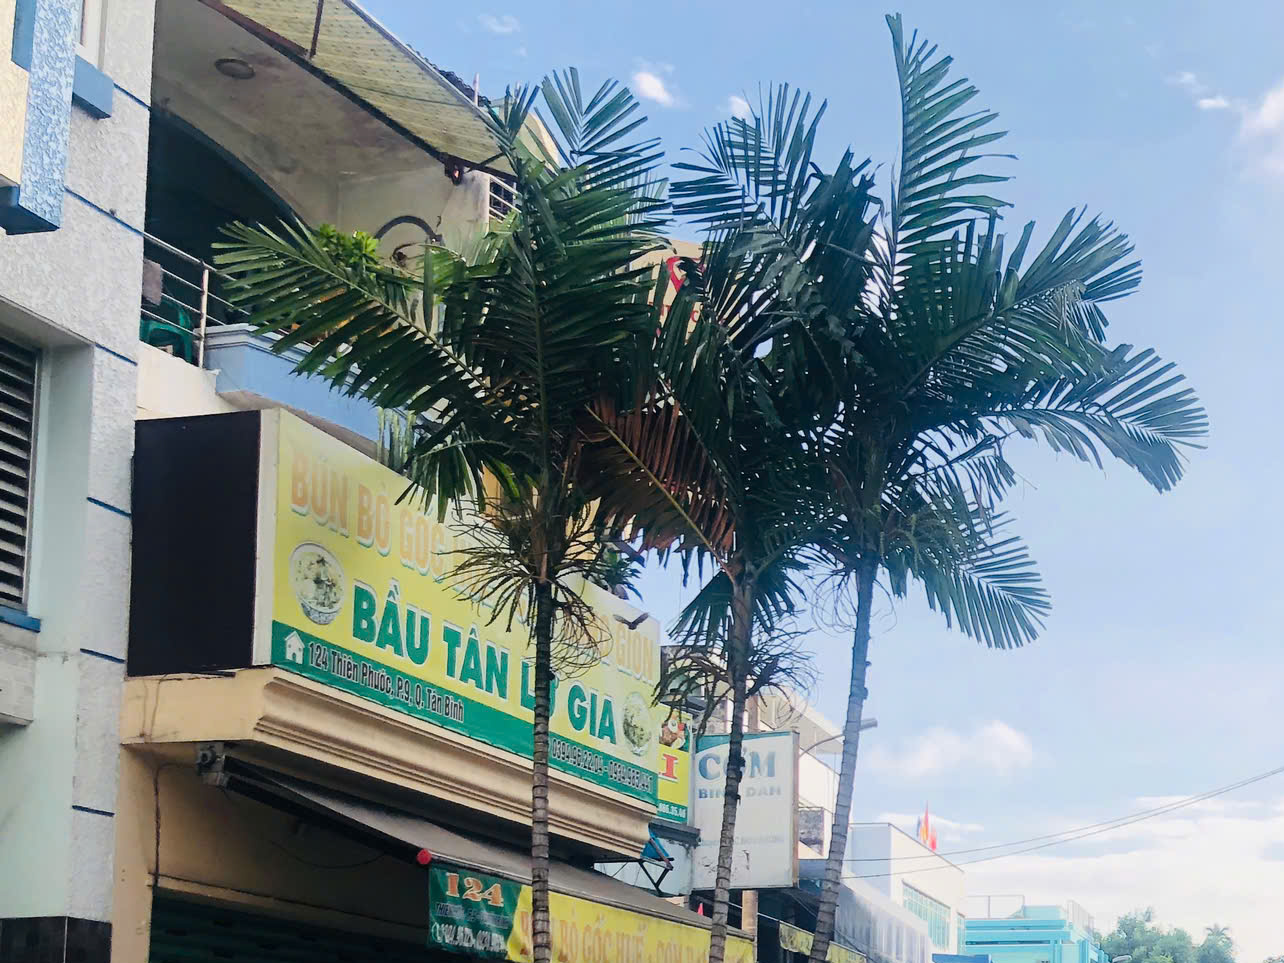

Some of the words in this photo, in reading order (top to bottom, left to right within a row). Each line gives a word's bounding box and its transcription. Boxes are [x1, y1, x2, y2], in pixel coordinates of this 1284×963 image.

[309, 642, 328, 671] 124
[331, 650, 359, 683] Thiên
[415, 684, 425, 709] Q.
[426, 688, 442, 712] Tân
[353, 577, 431, 666] BẦU
[443, 624, 509, 701] TÂN
[567, 683, 616, 746] GIA
[446, 872, 504, 907] 124
